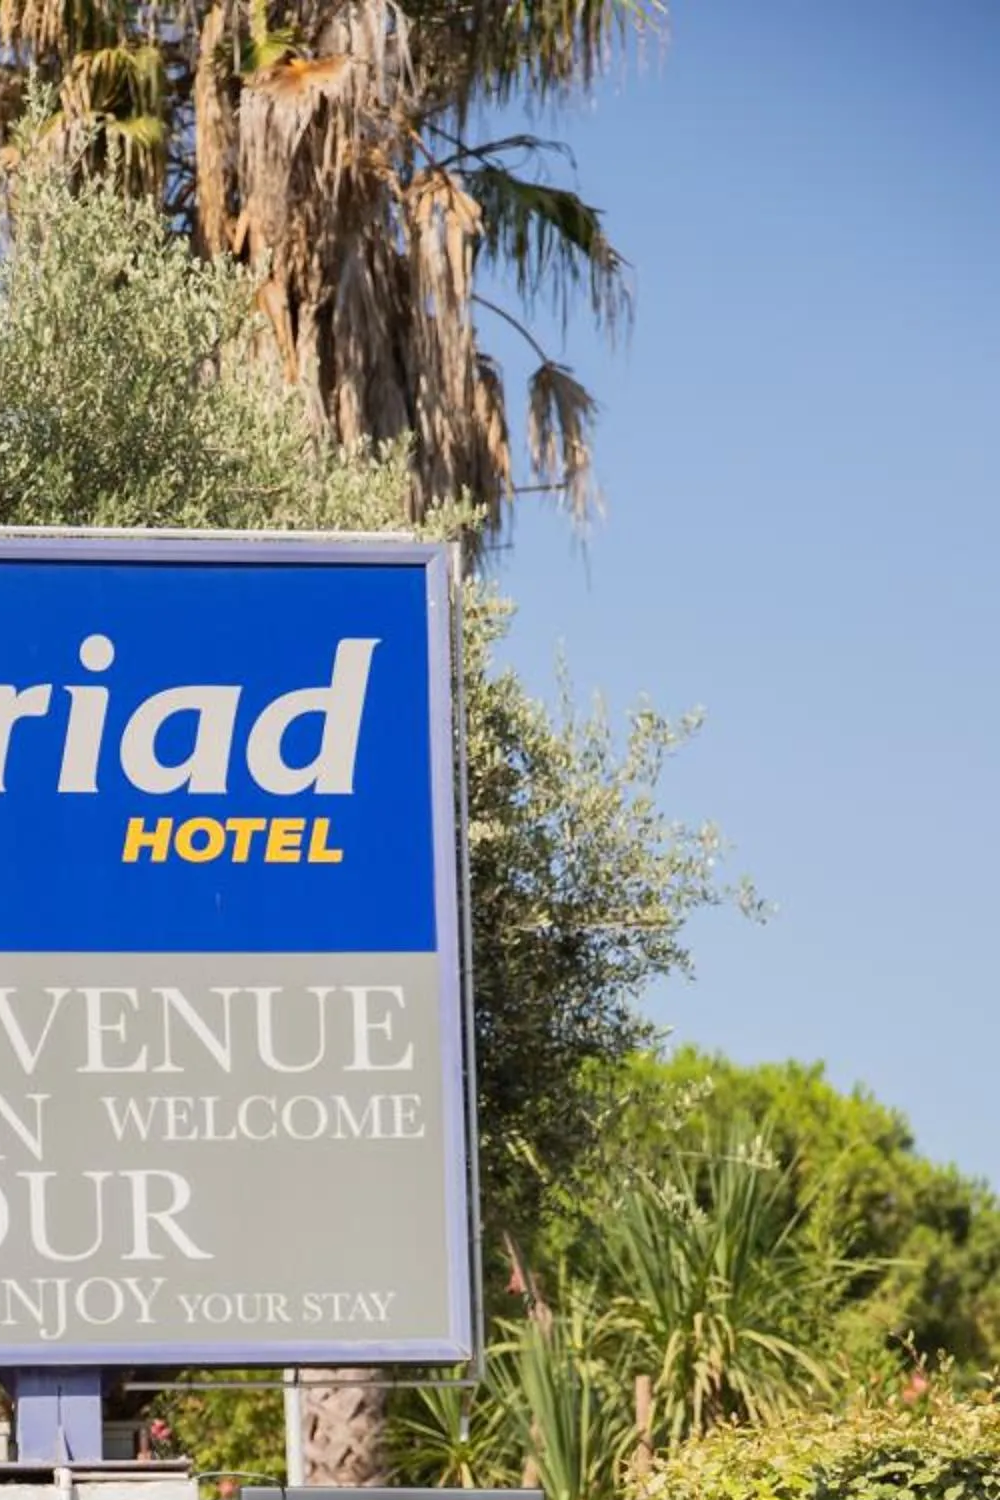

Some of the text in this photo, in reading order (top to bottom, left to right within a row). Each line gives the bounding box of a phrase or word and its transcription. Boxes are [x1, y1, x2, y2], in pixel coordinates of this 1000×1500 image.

[122, 816, 344, 864] HOTEL
[100, 1093, 426, 1143] WELCOME
[178, 1292, 293, 1325] YOUR
[301, 1290, 397, 1324] STAY
